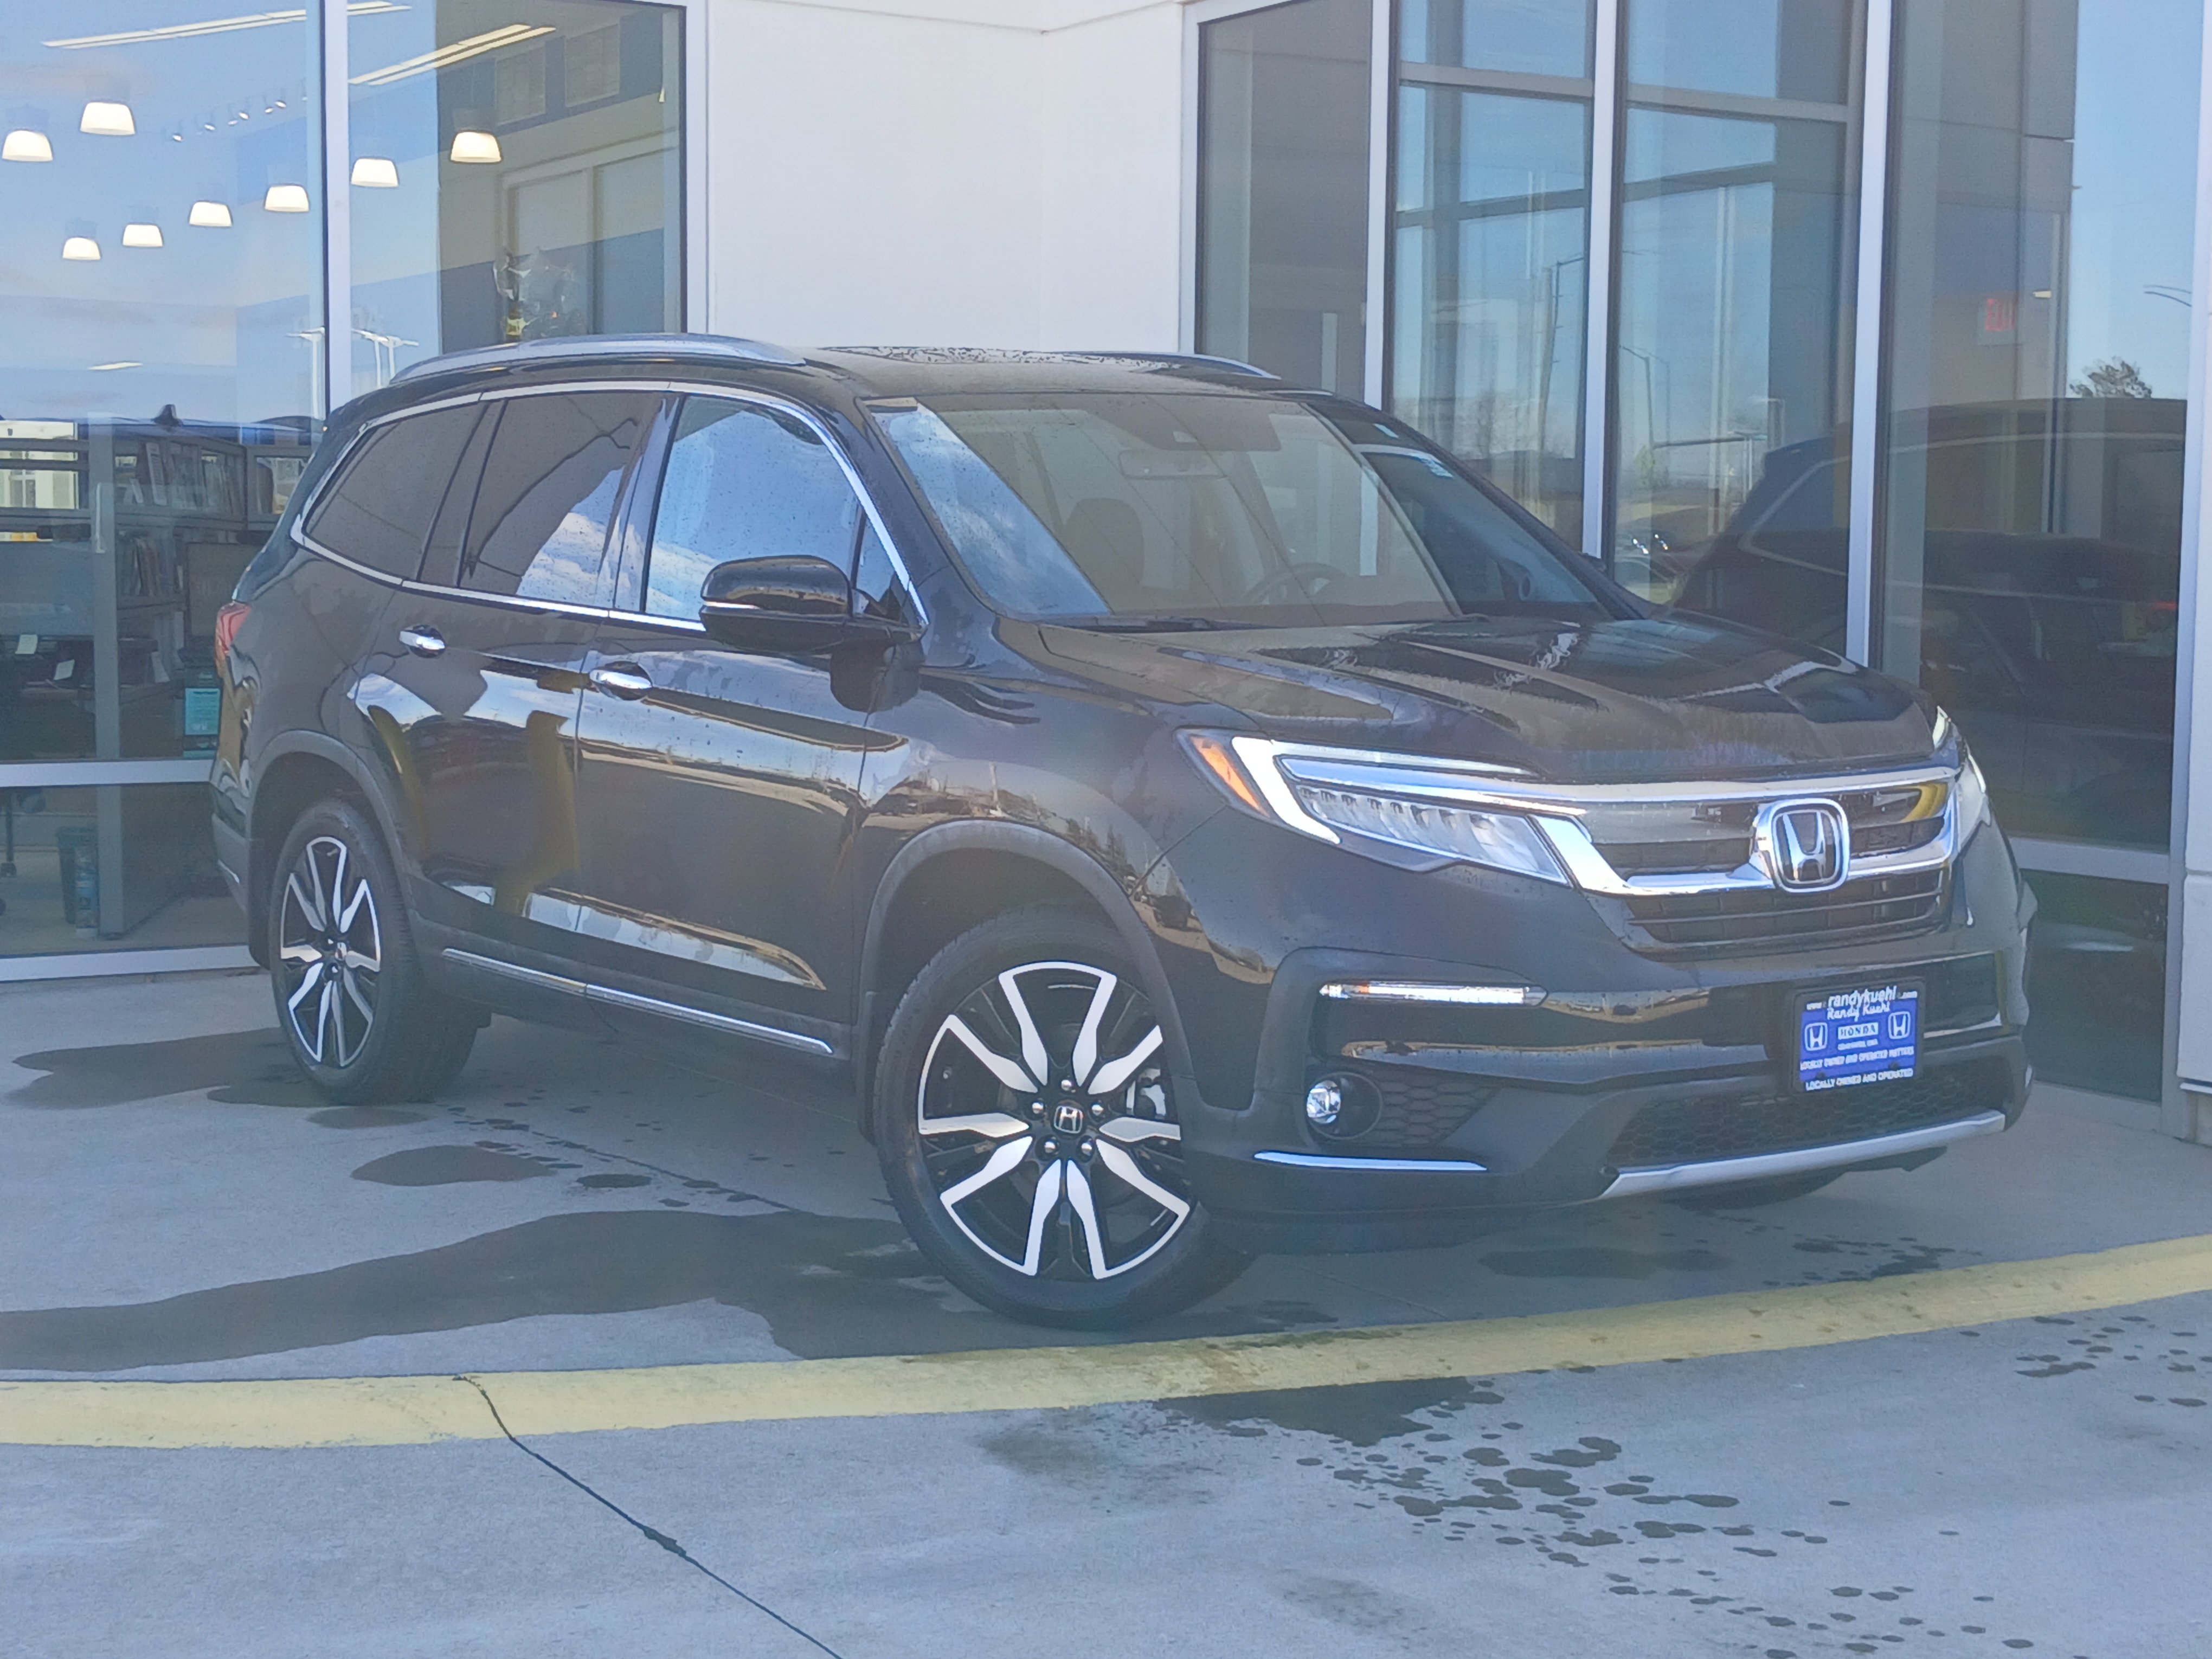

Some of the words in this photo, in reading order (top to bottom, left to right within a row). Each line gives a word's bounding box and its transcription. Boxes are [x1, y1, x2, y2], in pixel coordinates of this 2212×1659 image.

[1828, 985, 1897, 1008] randykuehl
[1827, 1004, 1860, 1022] Randy
[1841, 1024, 1876, 1037] HONDA
